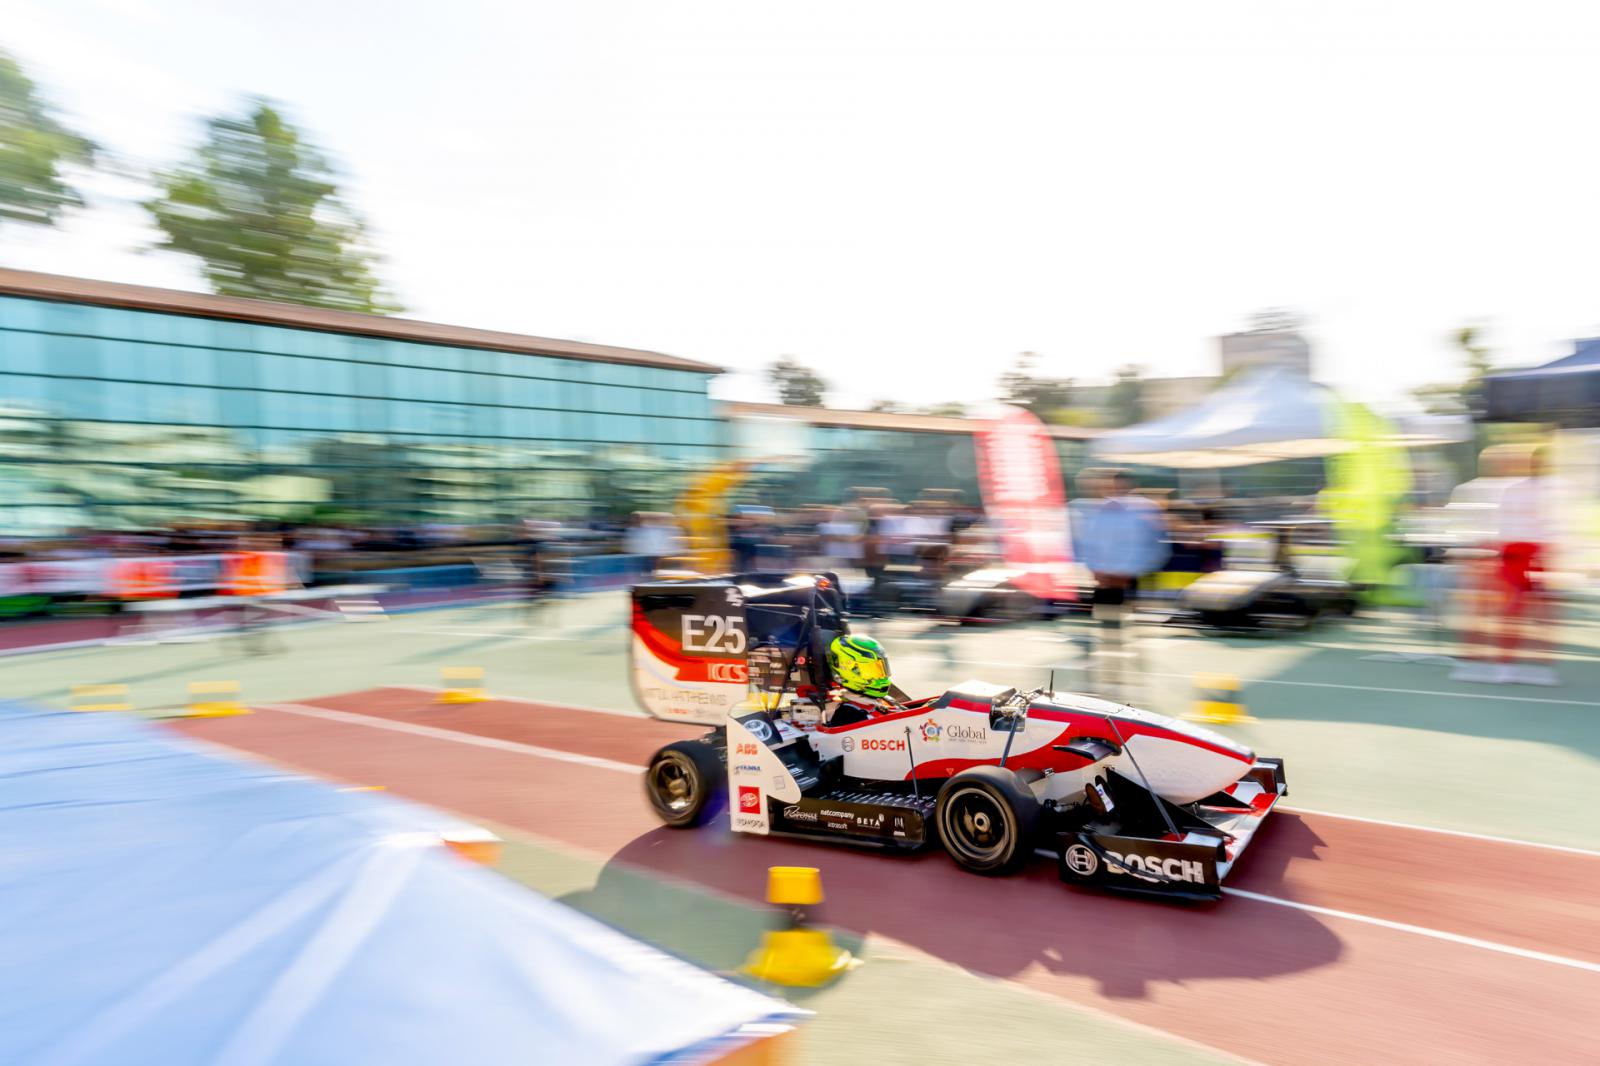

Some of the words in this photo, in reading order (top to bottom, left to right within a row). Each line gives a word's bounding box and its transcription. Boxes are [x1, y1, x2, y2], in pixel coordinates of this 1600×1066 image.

[681, 614, 746, 654] E25
[946, 724, 986, 740] Global
[861, 739, 905, 751] BOSCH
[856, 817, 880, 827] BETA
[1103, 850, 1205, 884] BOSCH
